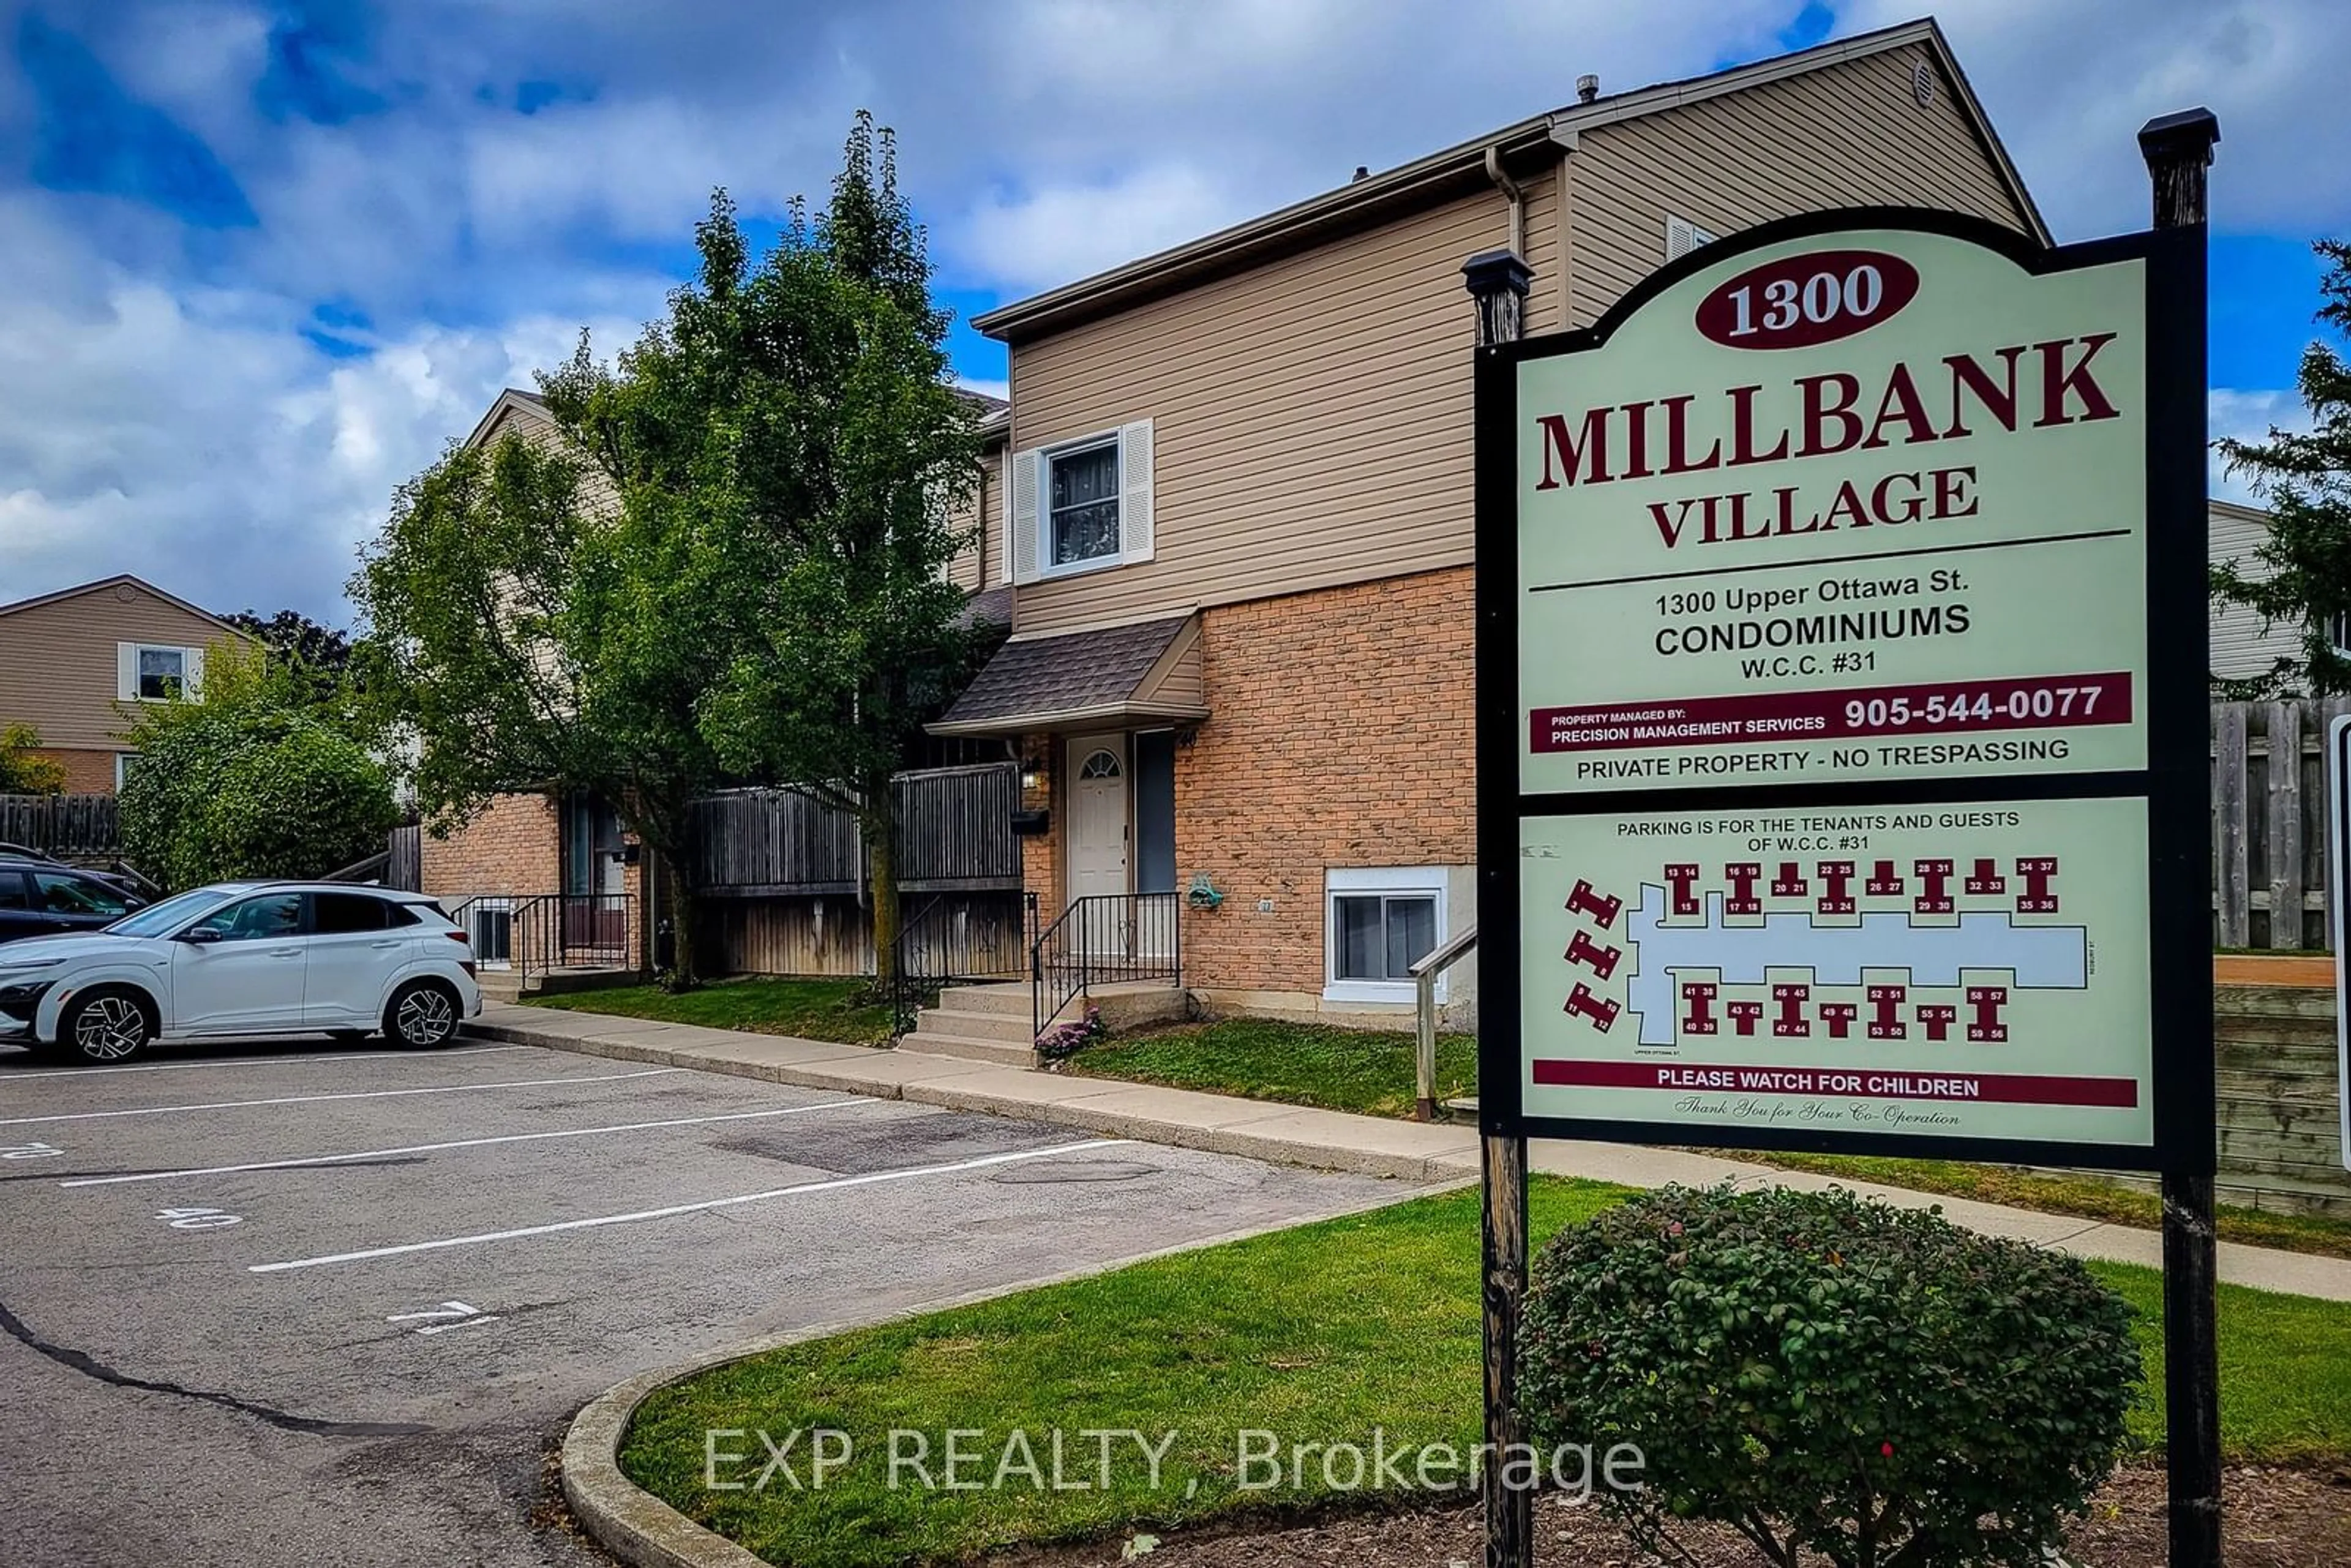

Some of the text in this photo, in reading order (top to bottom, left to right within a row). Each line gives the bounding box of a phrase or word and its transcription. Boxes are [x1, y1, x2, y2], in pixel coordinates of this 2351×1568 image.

[1728, 266, 1882, 336] 1300
[1536, 332, 2120, 490] MILLBANK
[1646, 467, 1978, 548] VILLAGE
[1657, 570, 1968, 615] 1300 Upper Ottawa St.
[1656, 604, 1969, 655] CONDOMINIUMS
[1742, 651, 1873, 678] W.C.C. #31
[1846, 687, 2101, 727] 905-544-0077
[1552, 710, 1685, 725] PROPERTY MANAGED BY:
[1552, 717, 1824, 743] PRECISION MANAGEMENT SERVICES
[1578, 759, 1670, 779] PRIVATE
[1679, 752, 1809, 775] PROPERTY
[1834, 749, 1869, 767] NO
[1878, 740, 2068, 765] TRESPASSING
[1618, 812, 2019, 835] PARKING IS FOR THE TENANTS AND GUESTS
[1749, 836, 1867, 851] OF W.C.C. #31
[1821, 866, 1832, 874] 22
[1918, 864, 1949, 872] 28 31
[2020, 862, 2053, 871] 34 37
[1668, 868, 1678, 877] 13
[1729, 867, 1757, 876] 16 19
[1793, 883, 1804, 892] 21
[1870, 882, 1901, 891] 26 27
[1970, 881, 2001, 890] 32 33
[1840, 902, 1851, 910] 24
[1918, 902, 1930, 910] 29
[2021, 901, 2054, 909] 35 36
[1685, 987, 1695, 996] 41
[1794, 989, 1805, 997] 45
[1871, 990, 1901, 999] 52 51
[1971, 991, 2003, 1000] 58 57
[1569, 1003, 1578, 1012] 11
[1731, 1006, 1742, 1015] 43
[1823, 1008, 1835, 1016] 49
[1921, 1010, 1933, 1018] 55
[1599, 1019, 1608, 1030] 12
[1686, 1022, 1714, 1031] 40 39
[1872, 1027, 1883, 1035] 53
[1971, 1029, 2003, 1038] 59 56
[1659, 1070, 1978, 1096] PLEASE WATCH FOR CHILDREN
[1674, 1095, 1960, 1127] Thank You for Your Co-Operation
[154, 1207, 243, 1228] 40
